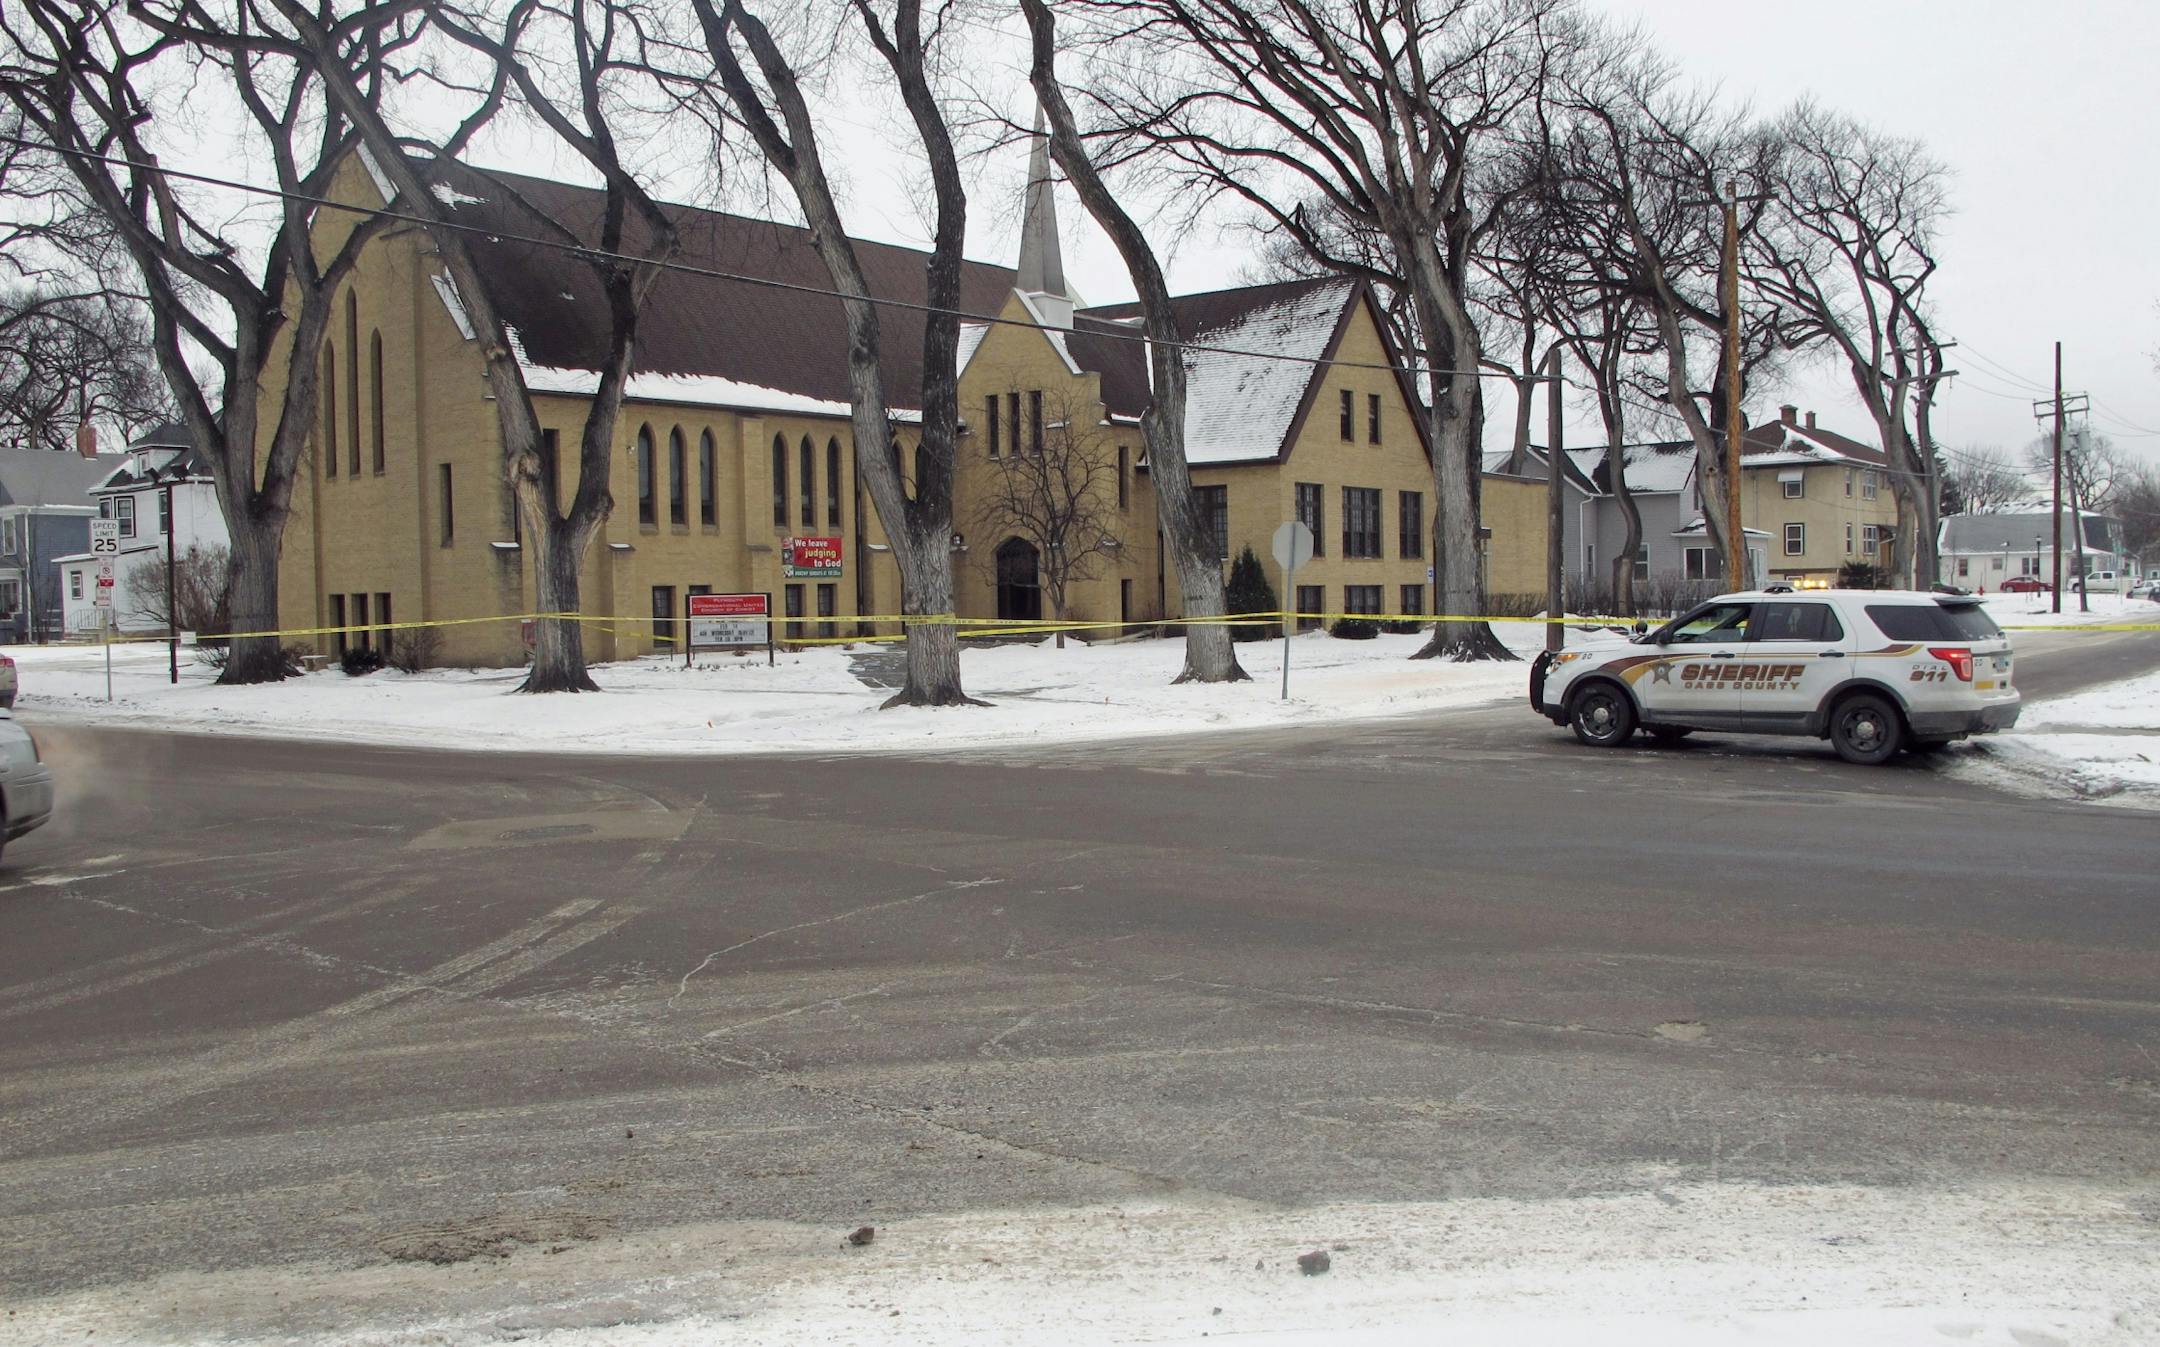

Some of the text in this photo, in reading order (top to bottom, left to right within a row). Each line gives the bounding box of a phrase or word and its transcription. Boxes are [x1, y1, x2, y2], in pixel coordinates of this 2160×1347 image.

[92, 522, 117, 530] SPEED
[94, 538, 117, 552] 25
[794, 539, 828, 547] We leave
[804, 548, 837, 559] judging
[813, 559, 842, 567] to God
[1680, 664, 1806, 682] SHERIFF
[1909, 670, 1948, 682] 911
[1684, 681, 1801, 690] CASS COUNTY
